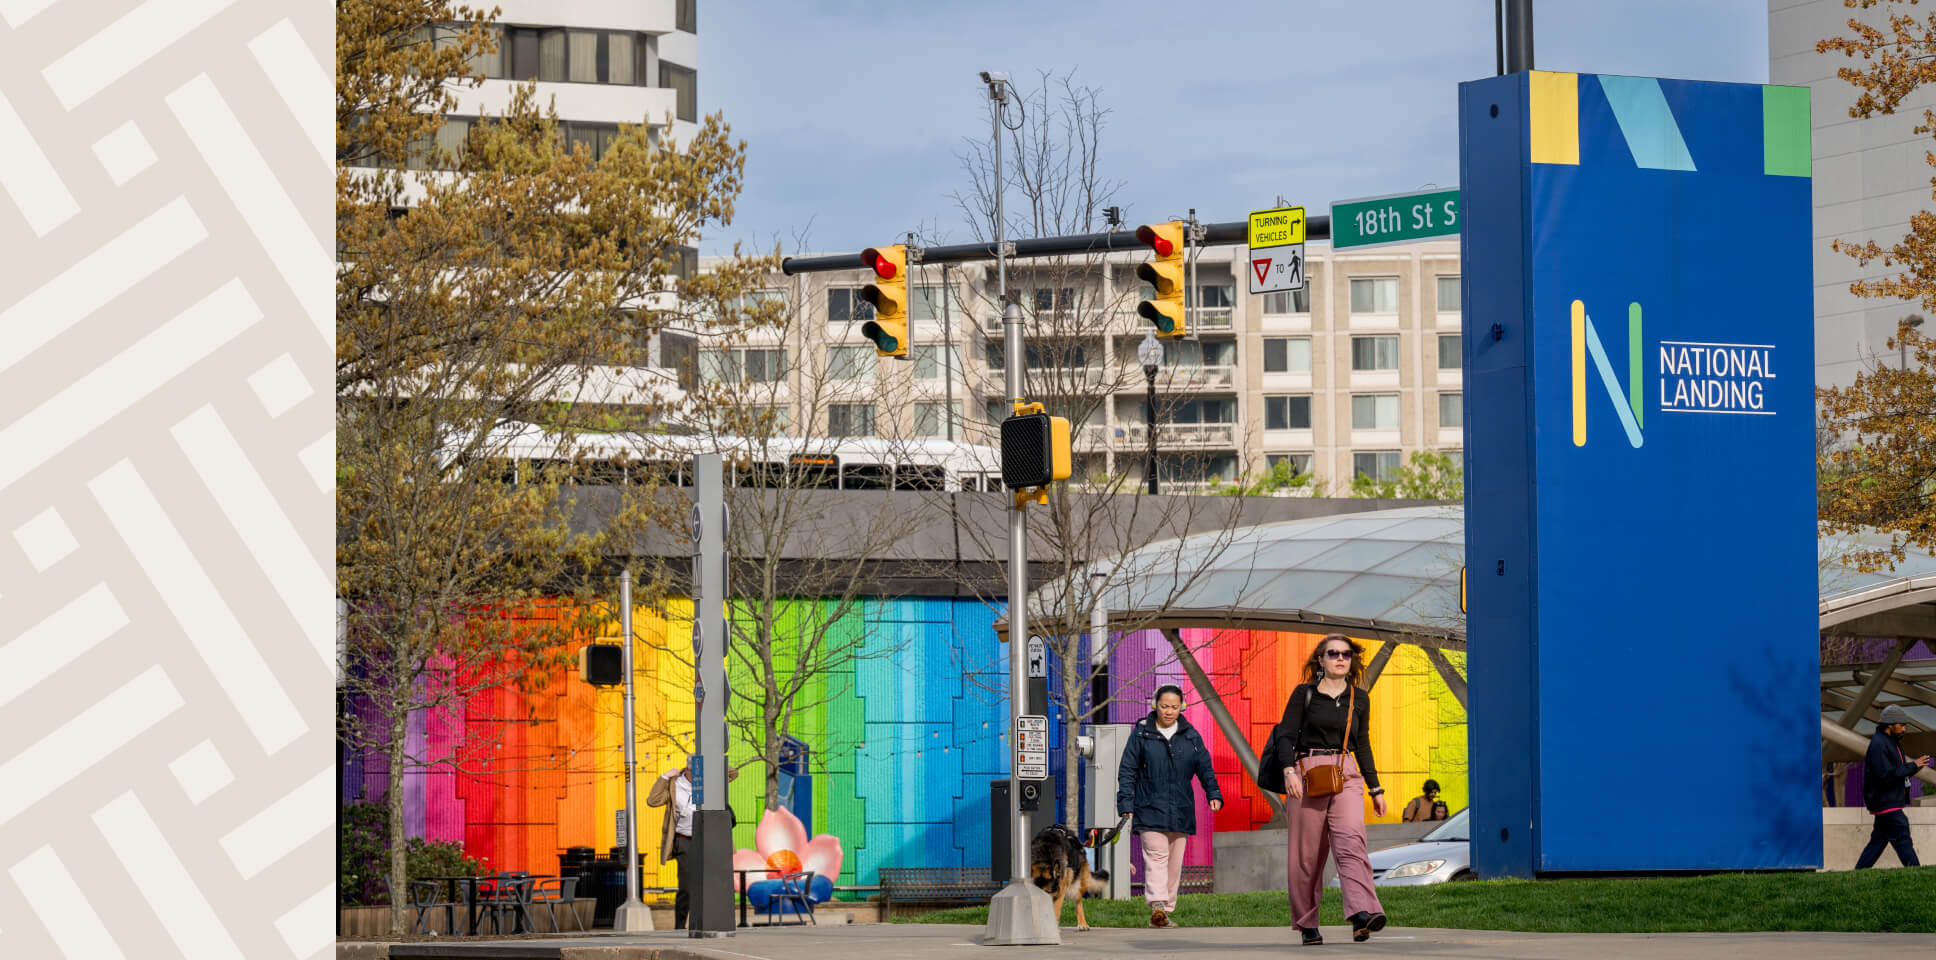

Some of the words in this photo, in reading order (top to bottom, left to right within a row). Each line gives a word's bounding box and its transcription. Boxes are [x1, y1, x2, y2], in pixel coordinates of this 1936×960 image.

[1255, 215, 1288, 228] TURNING
[1355, 206, 1401, 236] 18th
[1412, 202, 1433, 230] St
[1443, 201, 1456, 226] S
[1255, 230, 1288, 243] VEHICLES
[1275, 263, 1285, 274] TO
[1571, 299, 1644, 449] N
[1659, 346, 1777, 378] NATIONAL
[1660, 378, 1764, 410] LANDING
